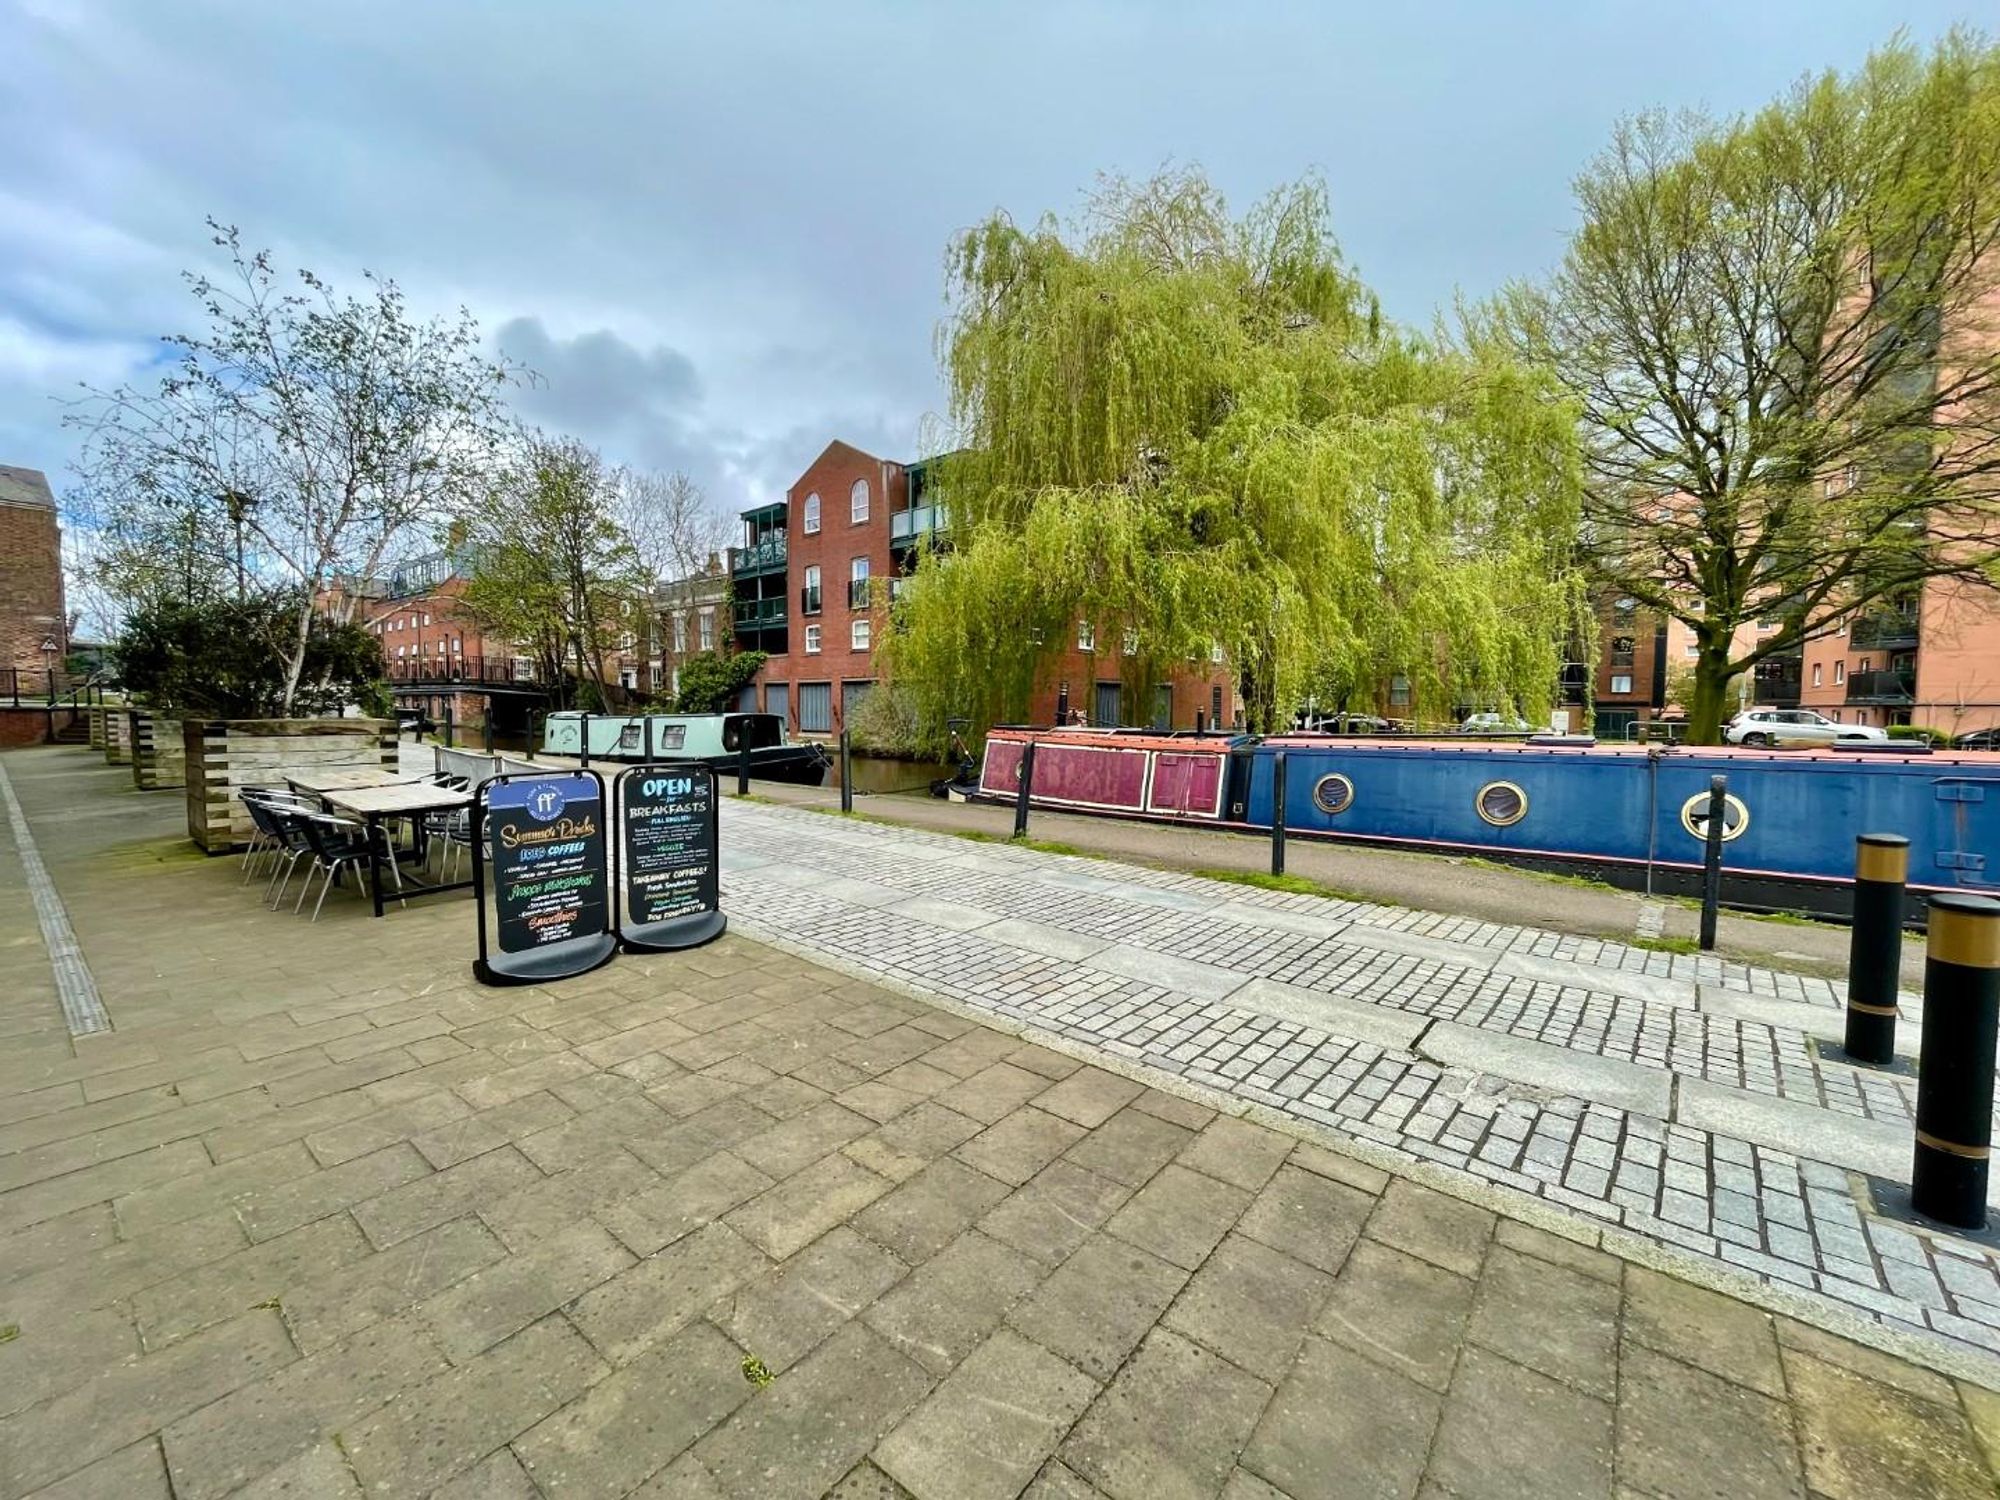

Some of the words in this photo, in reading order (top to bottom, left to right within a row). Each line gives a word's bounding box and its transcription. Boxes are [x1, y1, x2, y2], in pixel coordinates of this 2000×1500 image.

[642, 778, 692, 797] OPEN
[629, 801, 707, 819] BREAKFASTS
[548, 842, 586, 857] COFFEES
